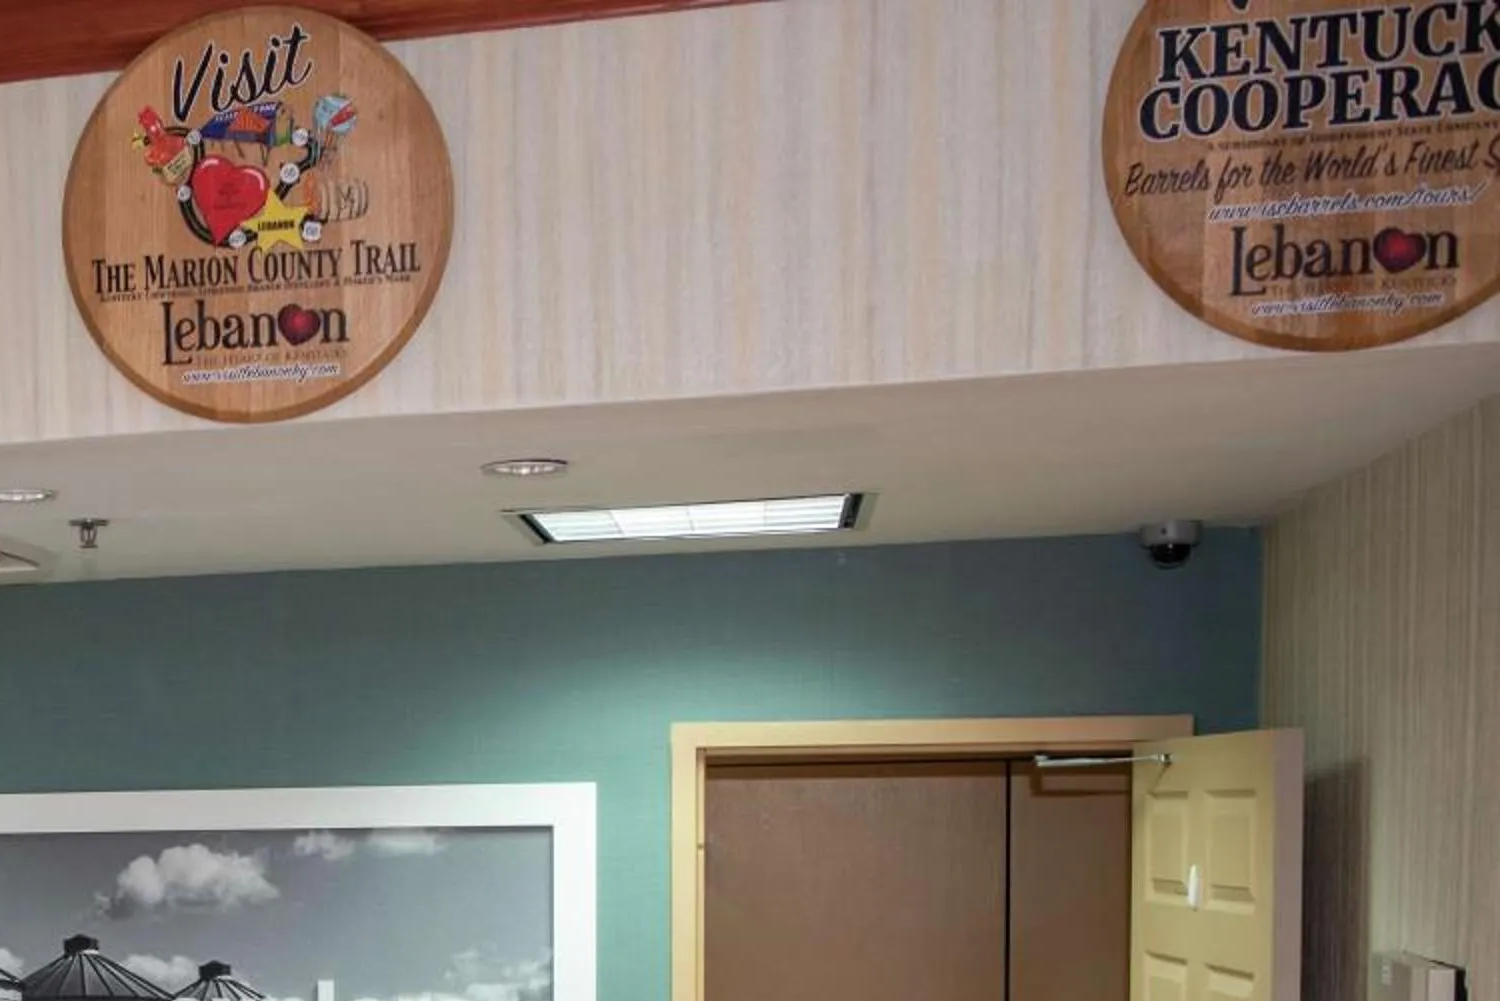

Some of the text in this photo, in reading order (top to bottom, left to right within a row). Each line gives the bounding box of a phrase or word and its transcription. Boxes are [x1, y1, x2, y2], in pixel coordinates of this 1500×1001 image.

[173, 23, 312, 122] Visit
[1124, 158, 1210, 196] Barrels
[1214, 154, 1253, 205] for
[1258, 151, 1297, 187] the
[1303, 142, 1398, 183] World's
[1404, 138, 1481, 174] Finest
[91, 258, 136, 294] THE
[144, 254, 239, 290] MARION
[247, 245, 343, 284] COUNTY
[350, 239, 421, 276] TRAIL
[1230, 222, 1461, 297] Lebanon
[161, 299, 350, 366] Lebanon
